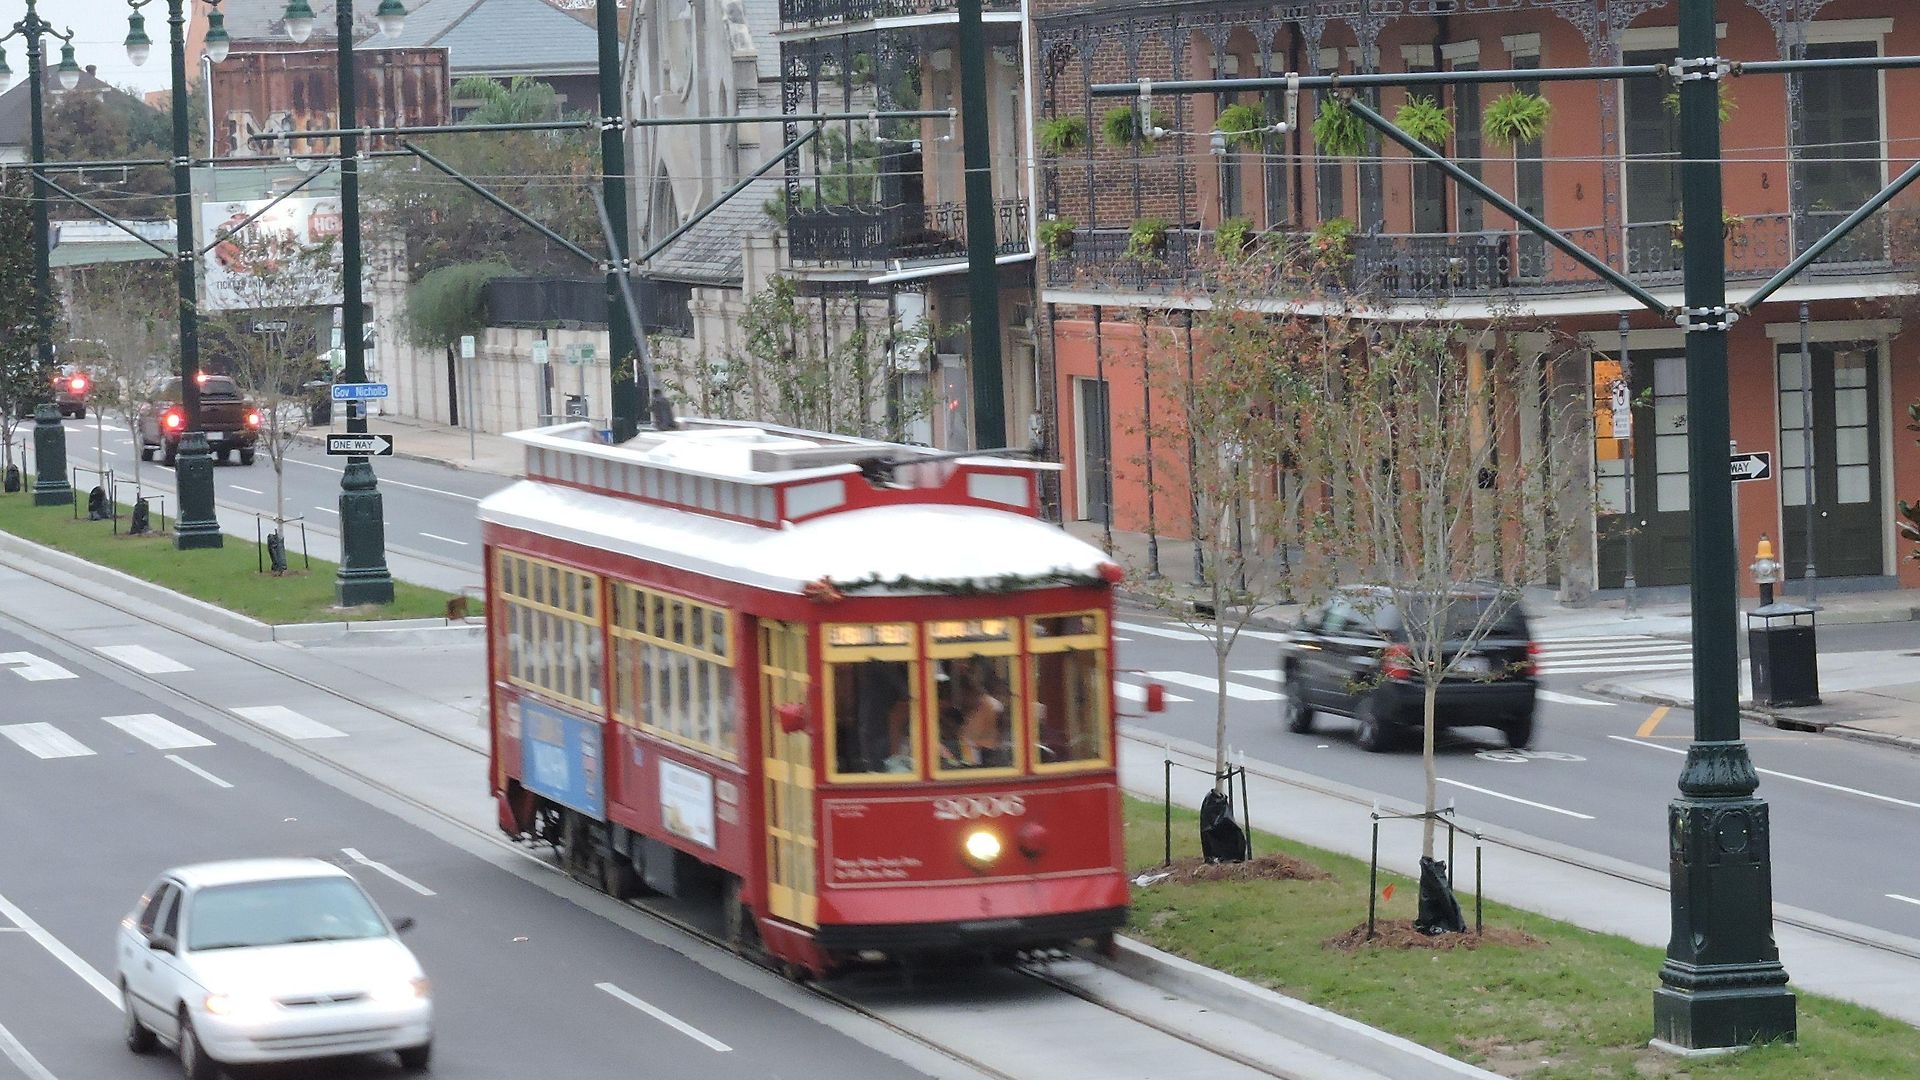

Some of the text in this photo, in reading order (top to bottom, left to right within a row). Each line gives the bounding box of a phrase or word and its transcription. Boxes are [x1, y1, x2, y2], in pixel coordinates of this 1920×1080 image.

[334, 385, 387, 397] Gov Nicholls
[333, 440, 373, 449] ONE WAY
[1731, 463, 1749, 472] WAY
